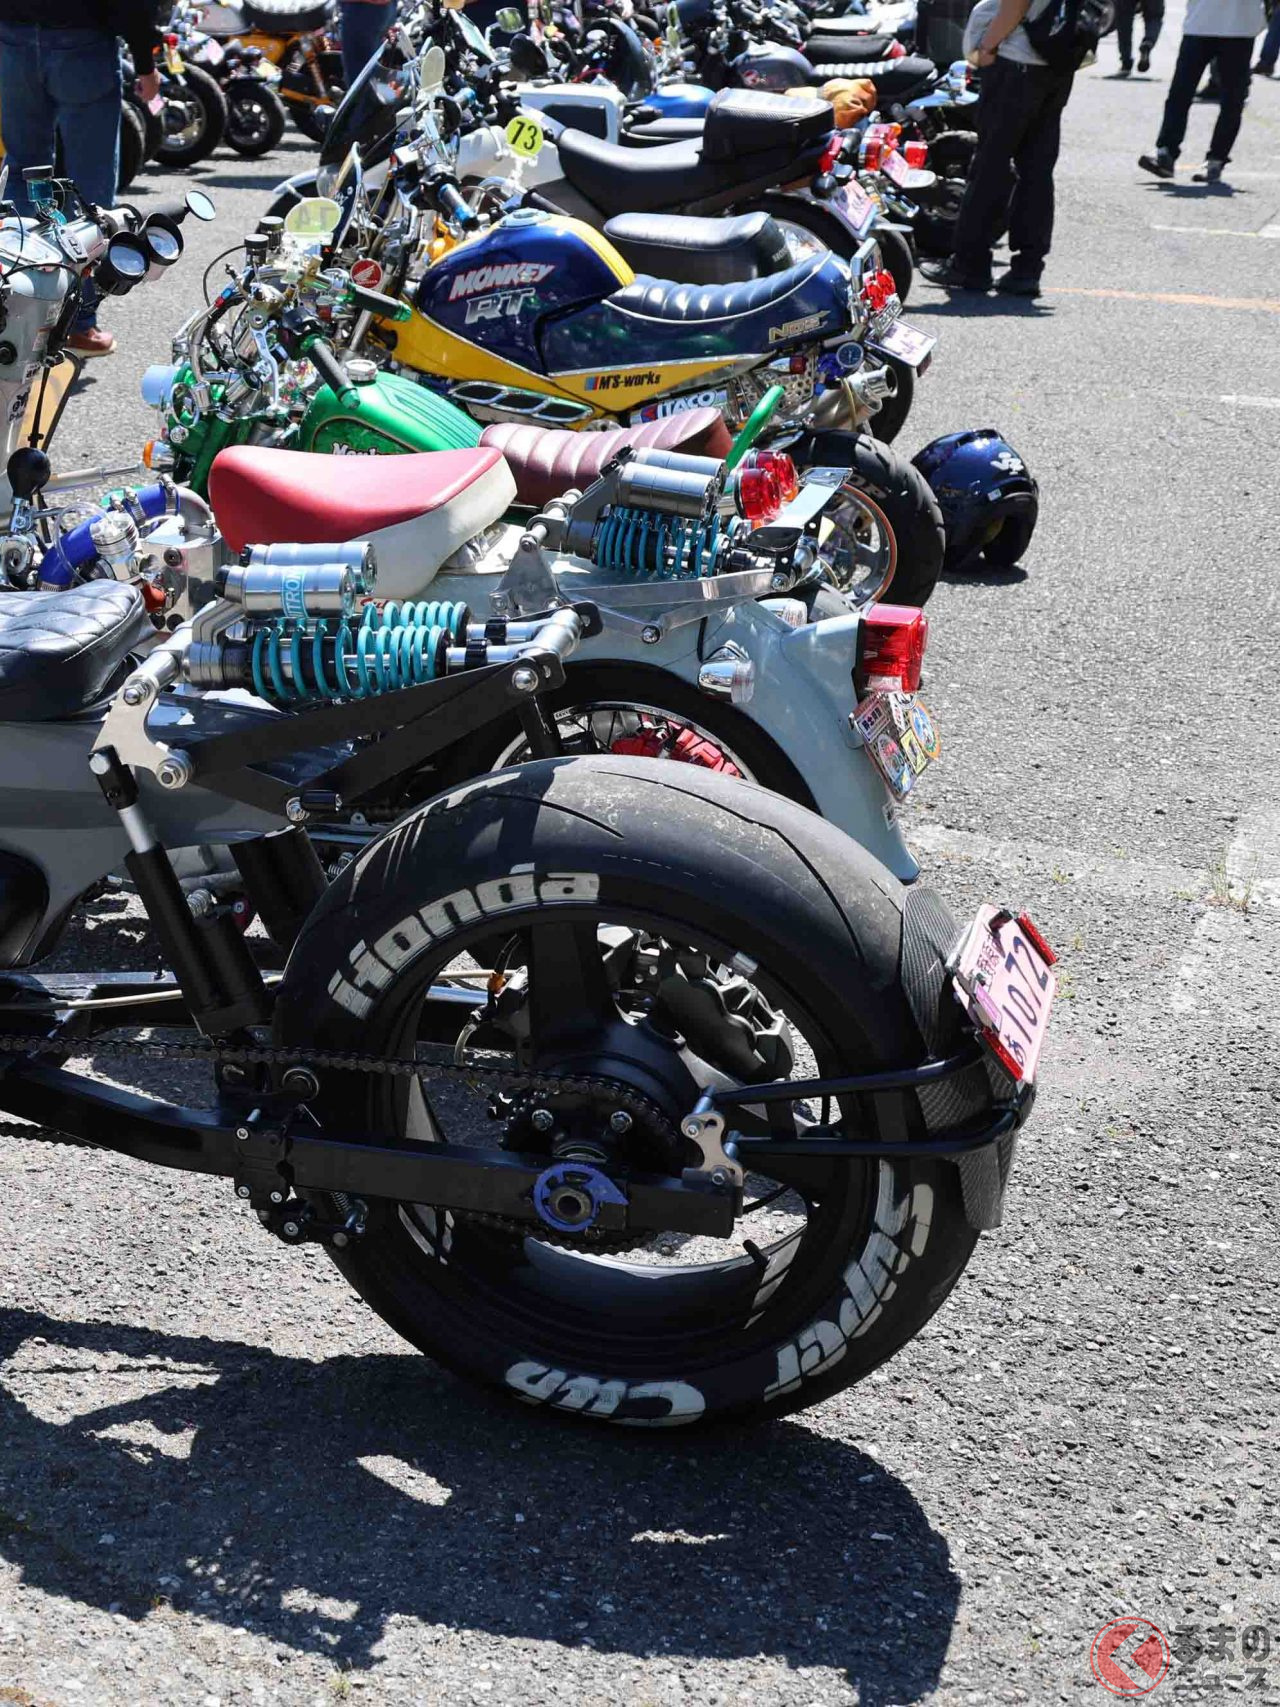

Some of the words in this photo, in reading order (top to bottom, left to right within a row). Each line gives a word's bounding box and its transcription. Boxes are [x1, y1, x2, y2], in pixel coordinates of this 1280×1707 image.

[511, 120, 538, 151] 73
[448, 263, 556, 301] MONKEY
[464, 287, 535, 325] RT
[327, 862, 600, 1022] Honda
[1002, 935, 1049, 1044] 1072
[1004, 1033, 1027, 1068] あ
[763, 1158, 934, 1403] Super
[504, 1360, 707, 1428] Cub
